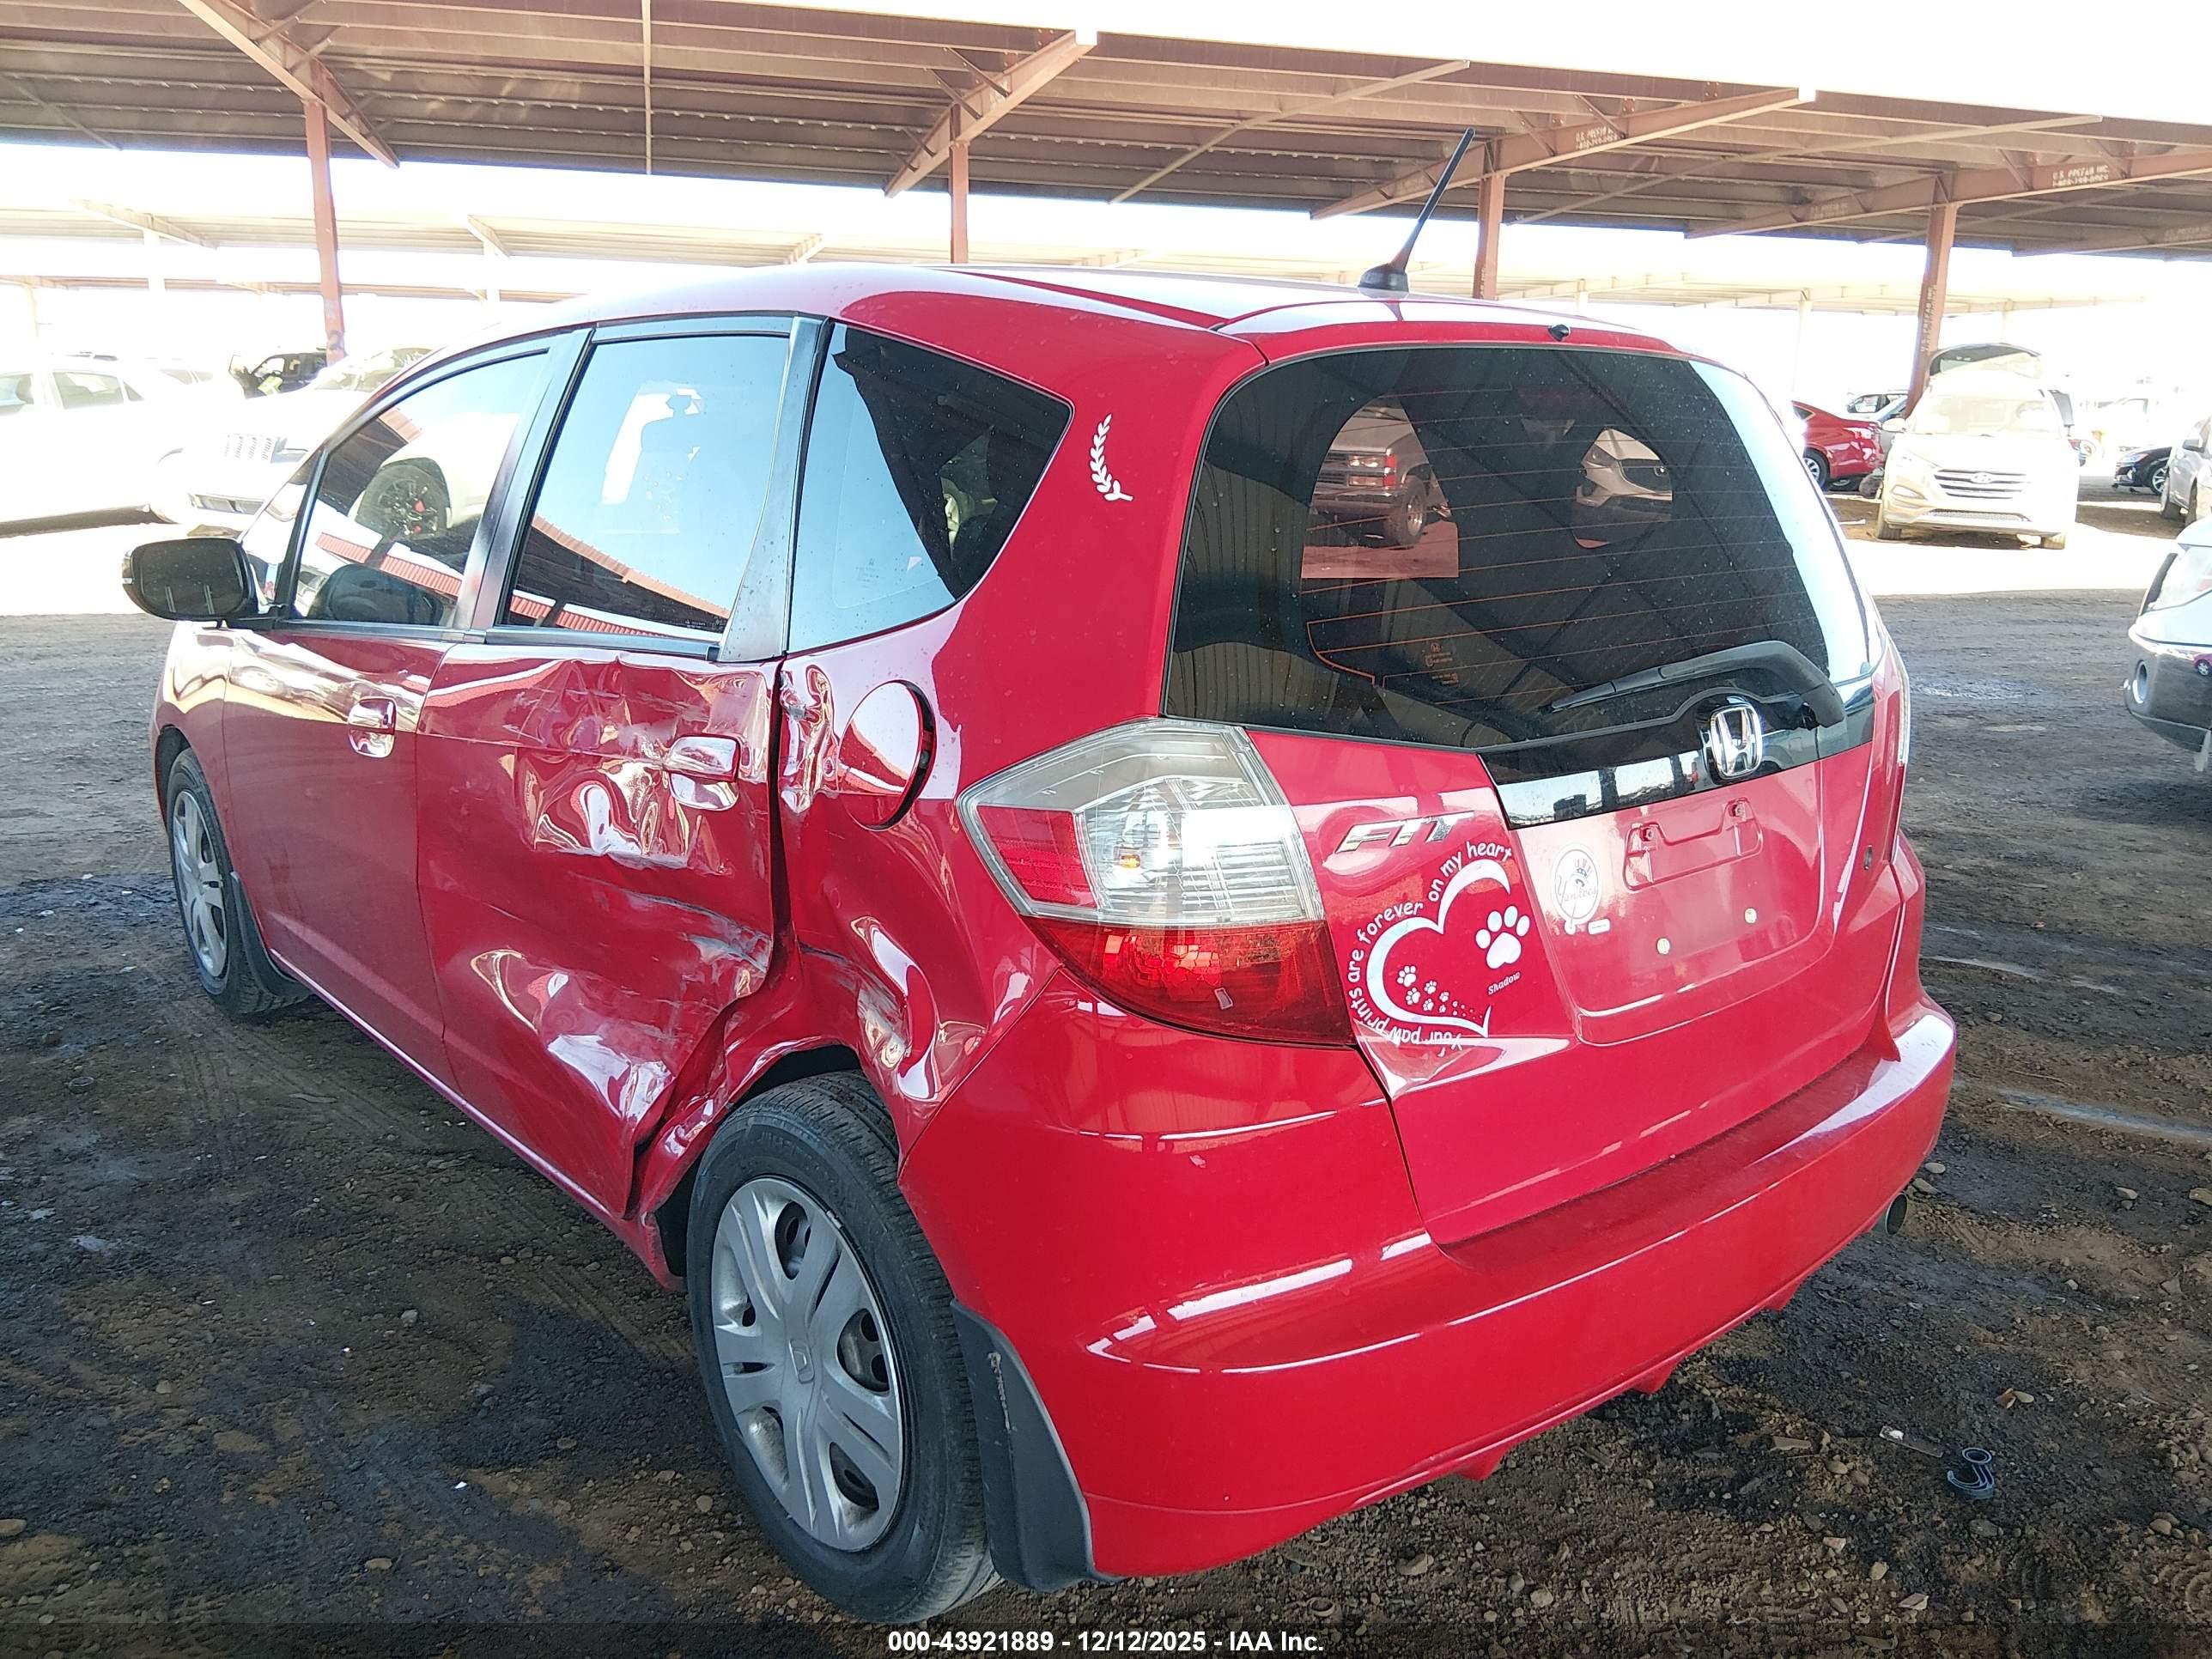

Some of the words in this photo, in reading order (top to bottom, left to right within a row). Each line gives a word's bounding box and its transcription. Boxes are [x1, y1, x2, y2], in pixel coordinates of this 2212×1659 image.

[1335, 810, 1475, 854] FIT
[1466, 841, 1512, 861] heart
[1440, 851, 1462, 878] my
[1428, 878, 1444, 902] on
[1357, 901, 1424, 945] forever
[1347, 949, 1364, 983] are
[1487, 971, 1521, 995] Shadow
[1348, 987, 1390, 1034] prints
[1389, 1026, 1422, 1045] paw
[1422, 1030, 1463, 1051] Your
